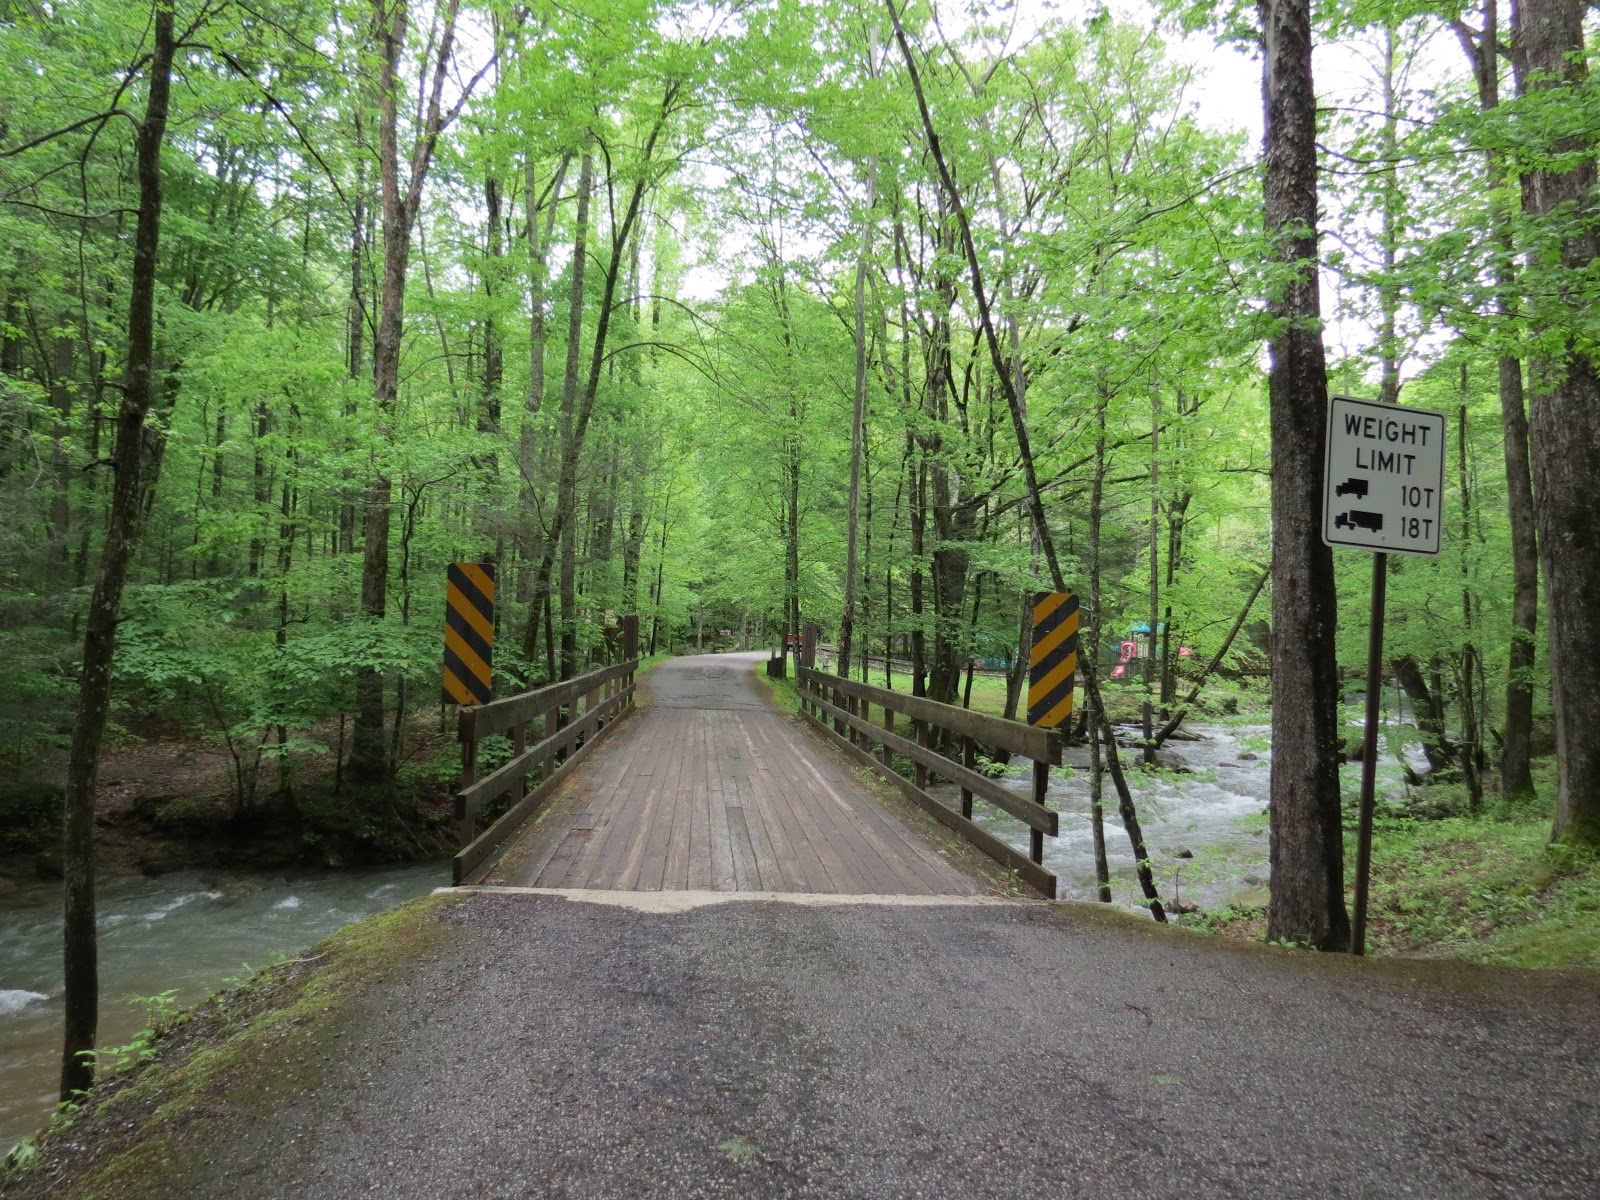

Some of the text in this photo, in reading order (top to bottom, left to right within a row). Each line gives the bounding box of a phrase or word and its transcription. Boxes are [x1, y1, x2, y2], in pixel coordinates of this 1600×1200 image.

[1344, 413, 1431, 447] WEIGHT
[1356, 447, 1416, 475] LIMIT
[1401, 485, 1434, 509] 10T
[1401, 516, 1433, 540] 18T
